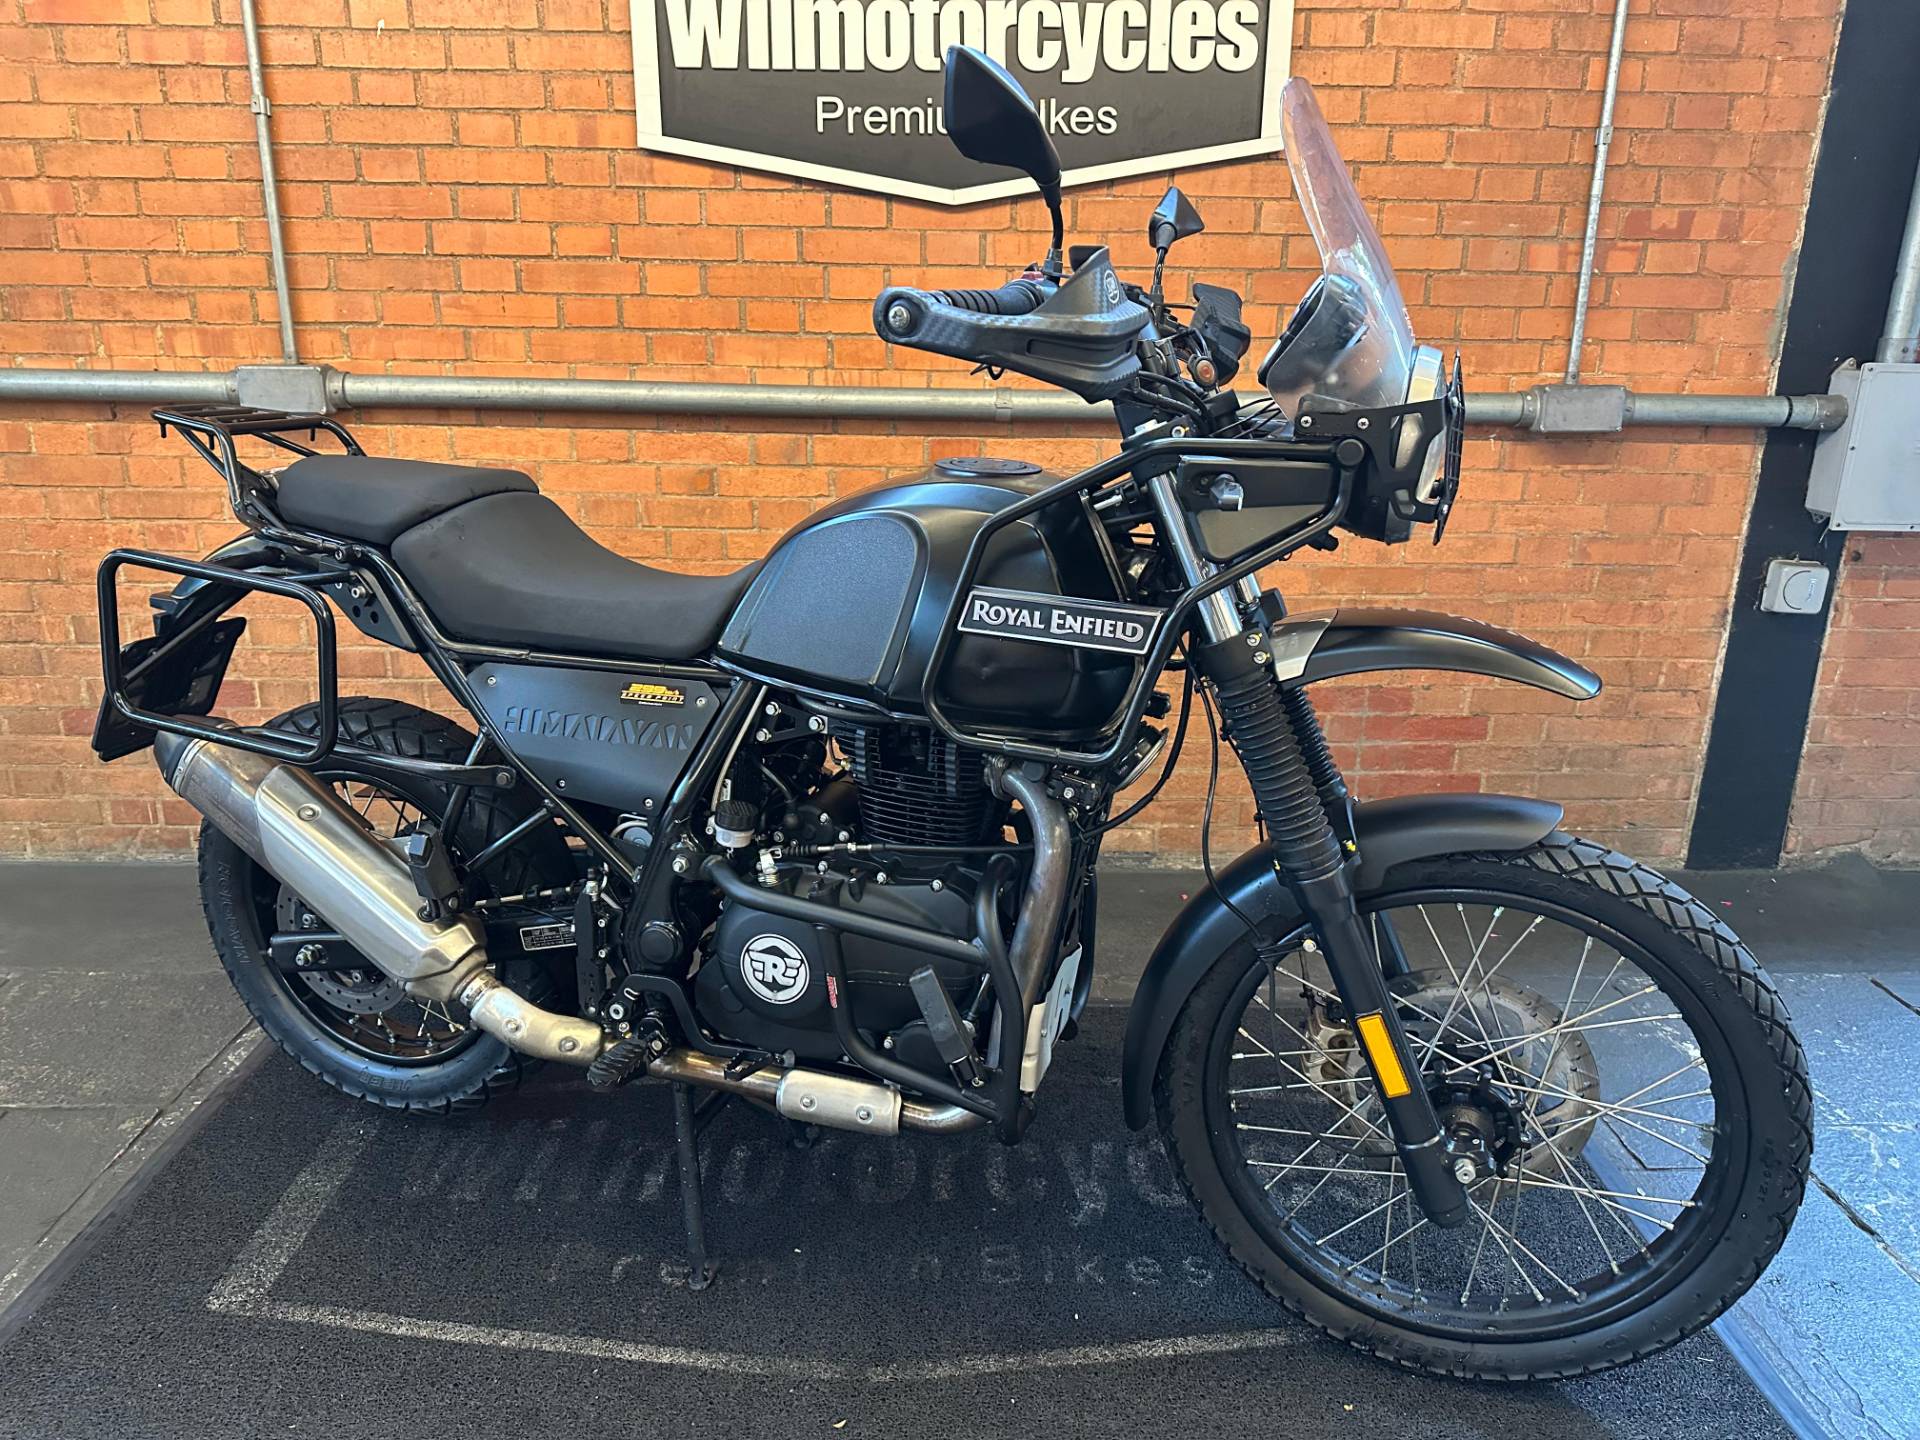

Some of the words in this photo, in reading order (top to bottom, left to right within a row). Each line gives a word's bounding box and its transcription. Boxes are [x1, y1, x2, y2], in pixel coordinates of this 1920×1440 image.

[816, 96, 948, 134] Premi
[972, 600, 1045, 629] ROYAL
[1050, 609, 1144, 643] ENFIELD
